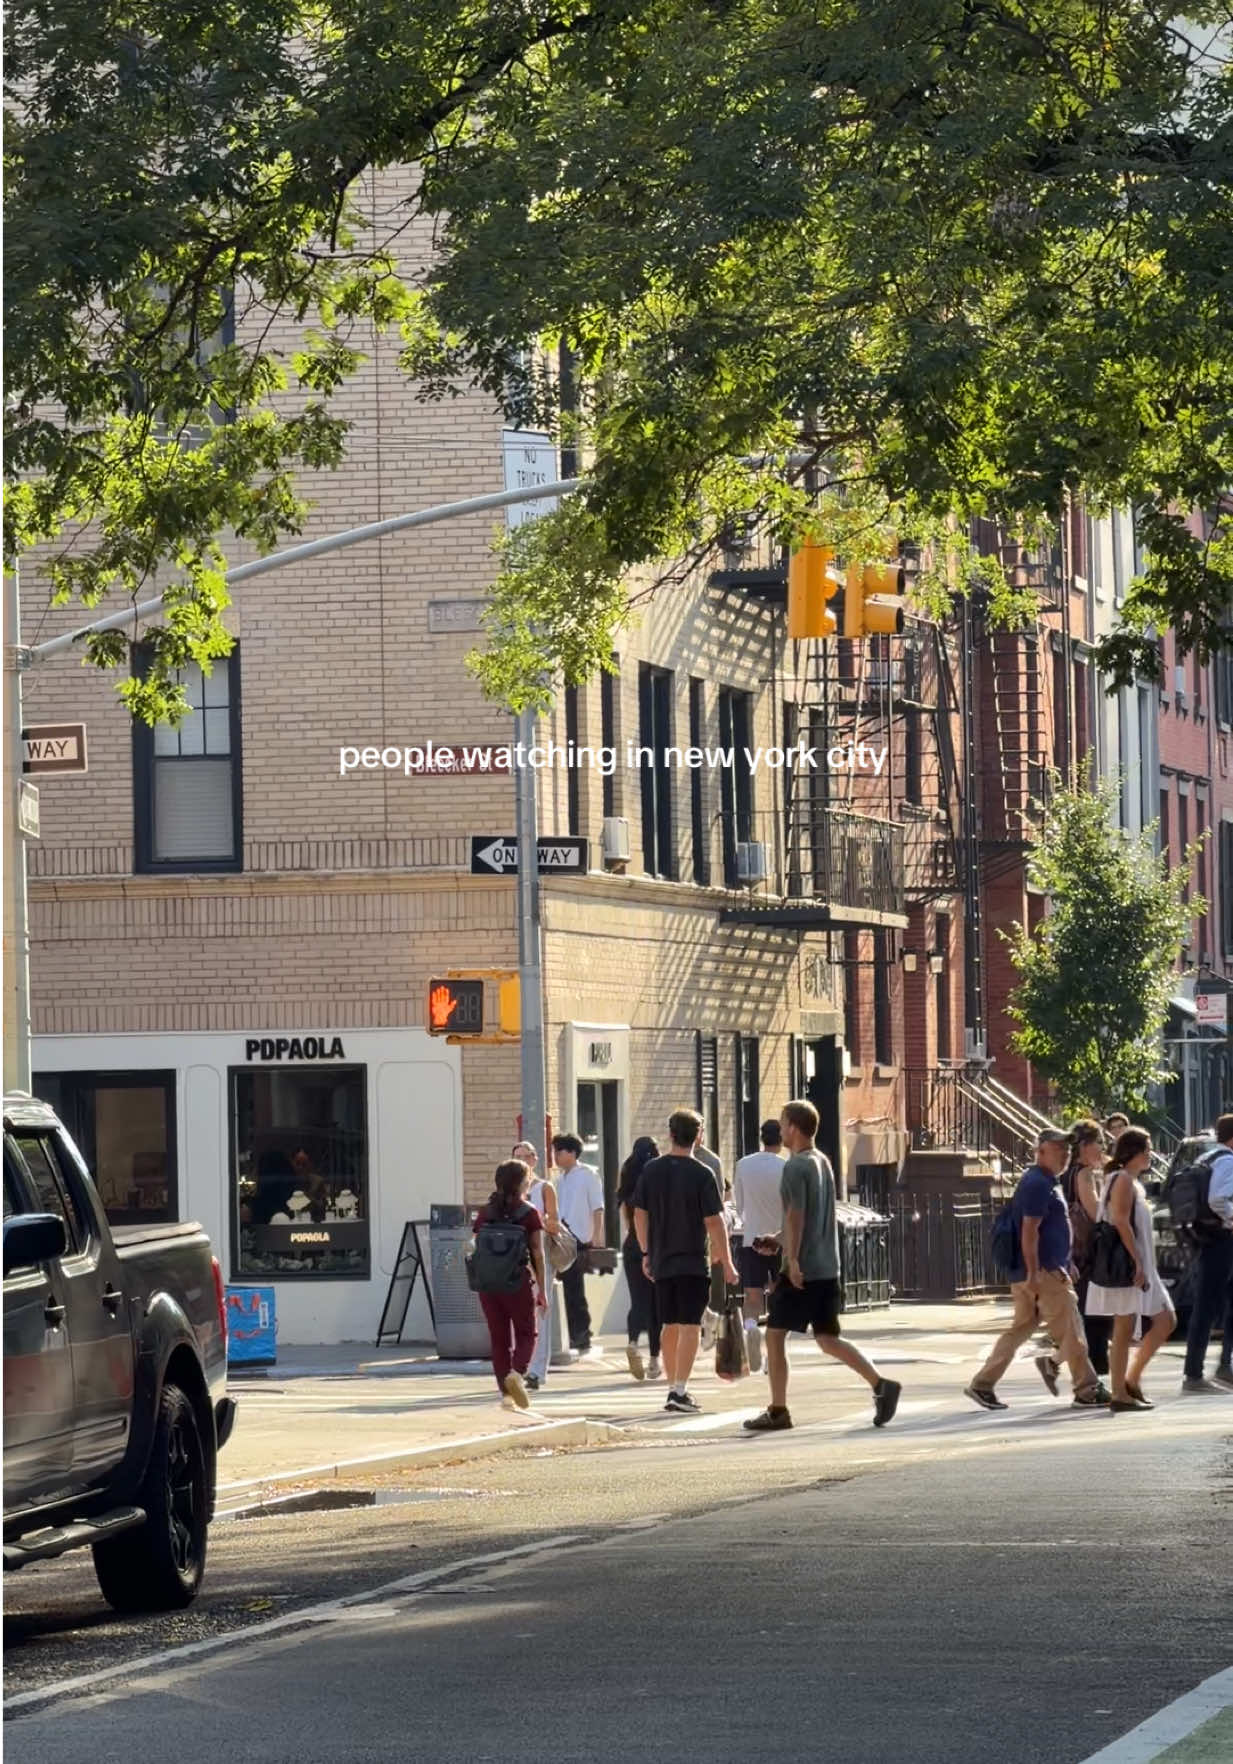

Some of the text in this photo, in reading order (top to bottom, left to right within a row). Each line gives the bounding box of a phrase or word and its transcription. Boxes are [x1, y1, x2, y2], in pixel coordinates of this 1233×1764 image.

[523, 446, 537, 464] NO
[26, 740, 69, 759] WAY
[493, 848, 571, 864] ON WAY
[246, 1037, 345, 1061] PDPAOLA
